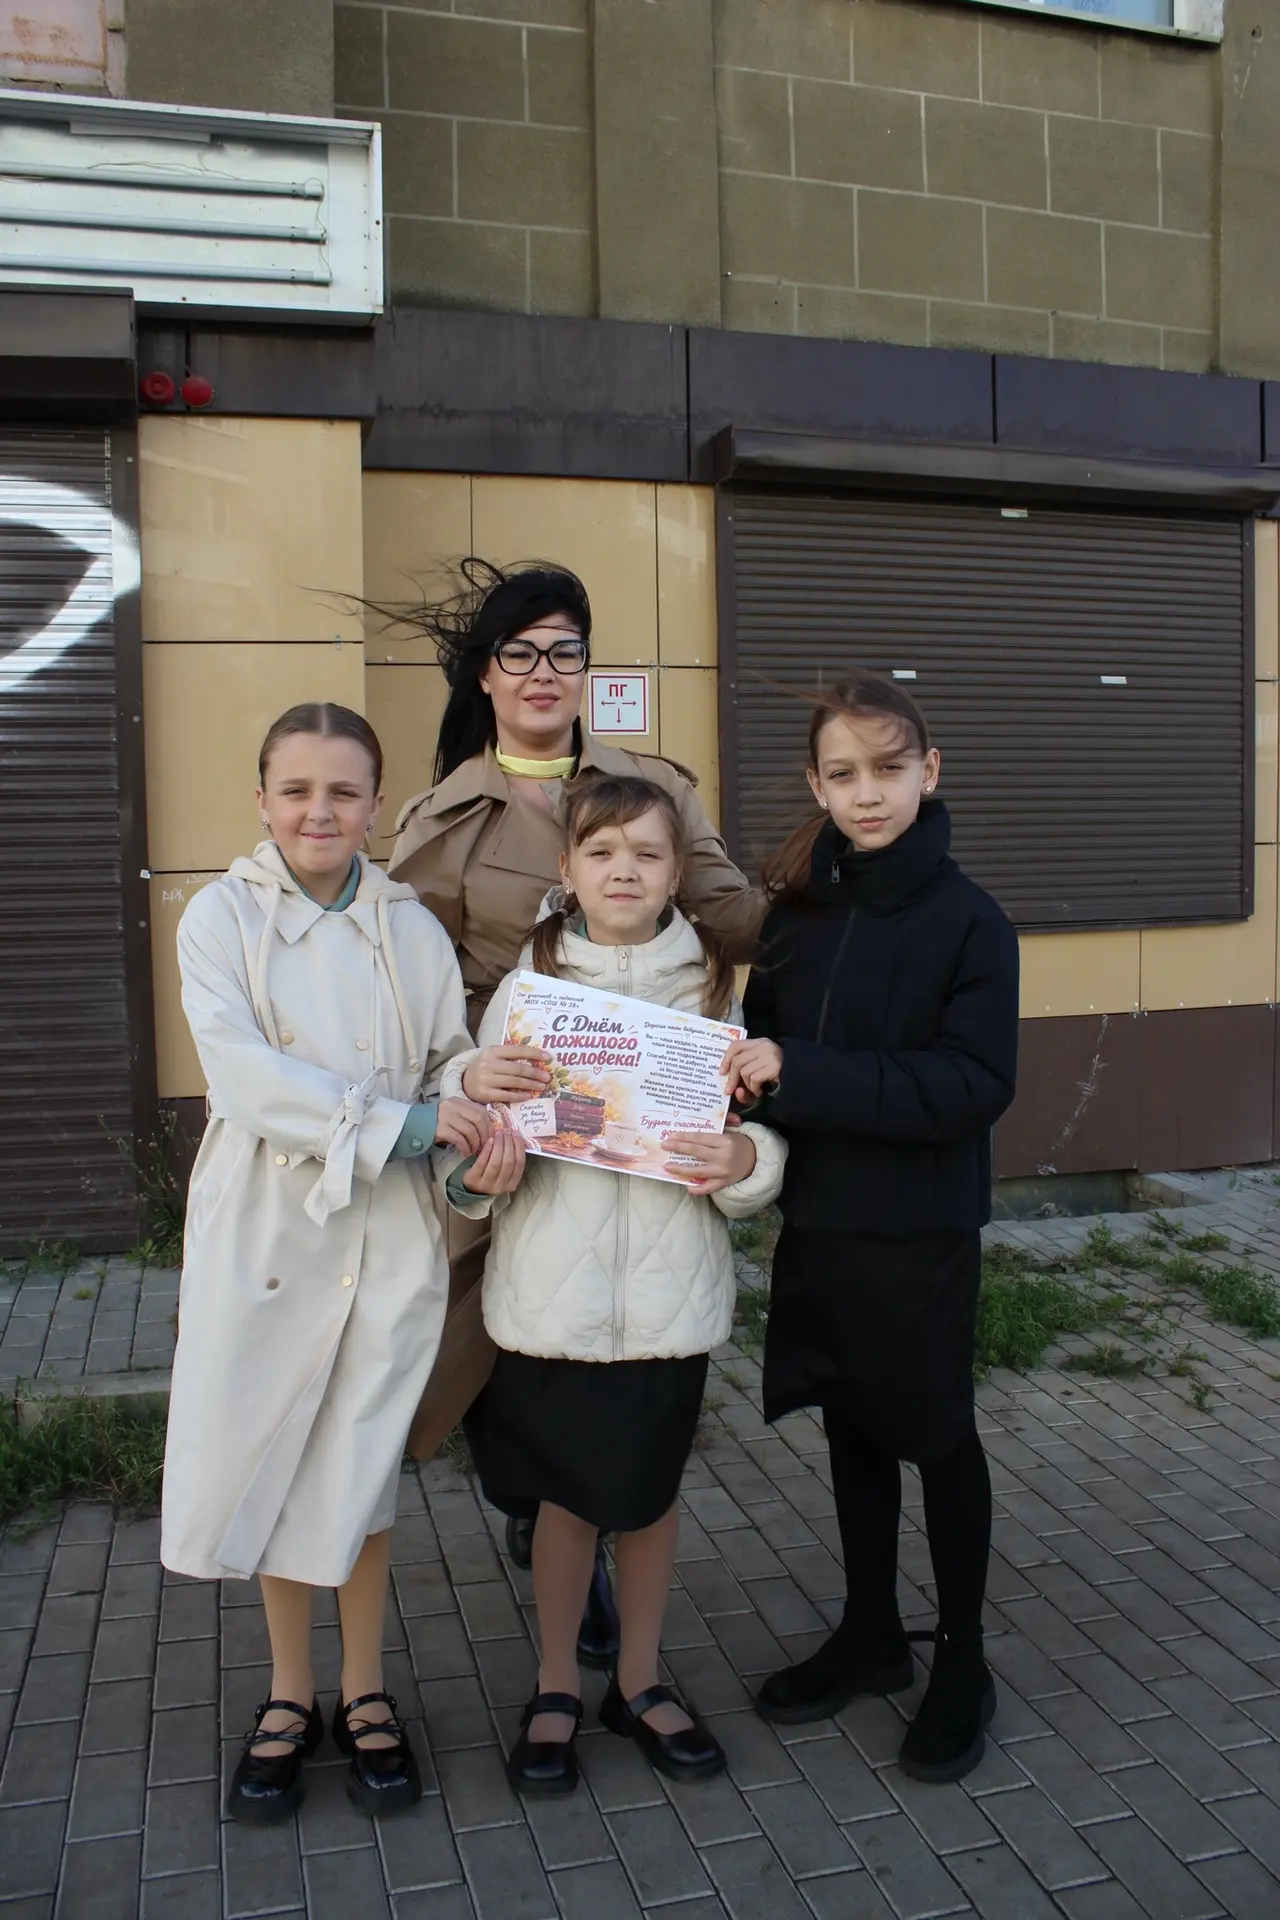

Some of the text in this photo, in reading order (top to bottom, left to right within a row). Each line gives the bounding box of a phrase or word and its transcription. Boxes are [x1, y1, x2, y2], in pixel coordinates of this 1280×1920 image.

[609, 684, 628, 697] ПГ
[552, 1014, 624, 1034] С Днём
[644, 1022, 666, 1030] Дорогие
[682, 1026, 706, 1035] бабушки
[542, 1034, 638, 1050] пожилого
[674, 1039, 698, 1049] мудрость,
[714, 1046, 728, 1054] опор
[556, 1050, 642, 1067] человека!
[666, 1044, 698, 1053] вдохновение
[703, 1051, 723, 1059] пример
[676, 1052, 708, 1062] подражания.
[646, 1052, 668, 1060] Спасибо
[685, 1059, 707, 1068] доброту,
[650, 1072, 672, 1080] который
[665, 1068, 693, 1077] бесценный
[695, 1068, 714, 1076] сердец,
[644, 1079, 665, 1087] Желаем
[676, 1085, 699, 1094] крепкого
[699, 1090, 722, 1099] здоровья,
[646, 1092, 670, 1100] внимания
[671, 1095, 691, 1105] близких
[668, 1090, 685, 1098] жизни,
[686, 1094, 708, 1102] радости,
[708, 1098, 723, 1106] уюта,
[520, 1102, 544, 1110] Спасибо
[678, 1104, 702, 1112] новостей!
[640, 1115, 717, 1131] Будьте счастливы,
